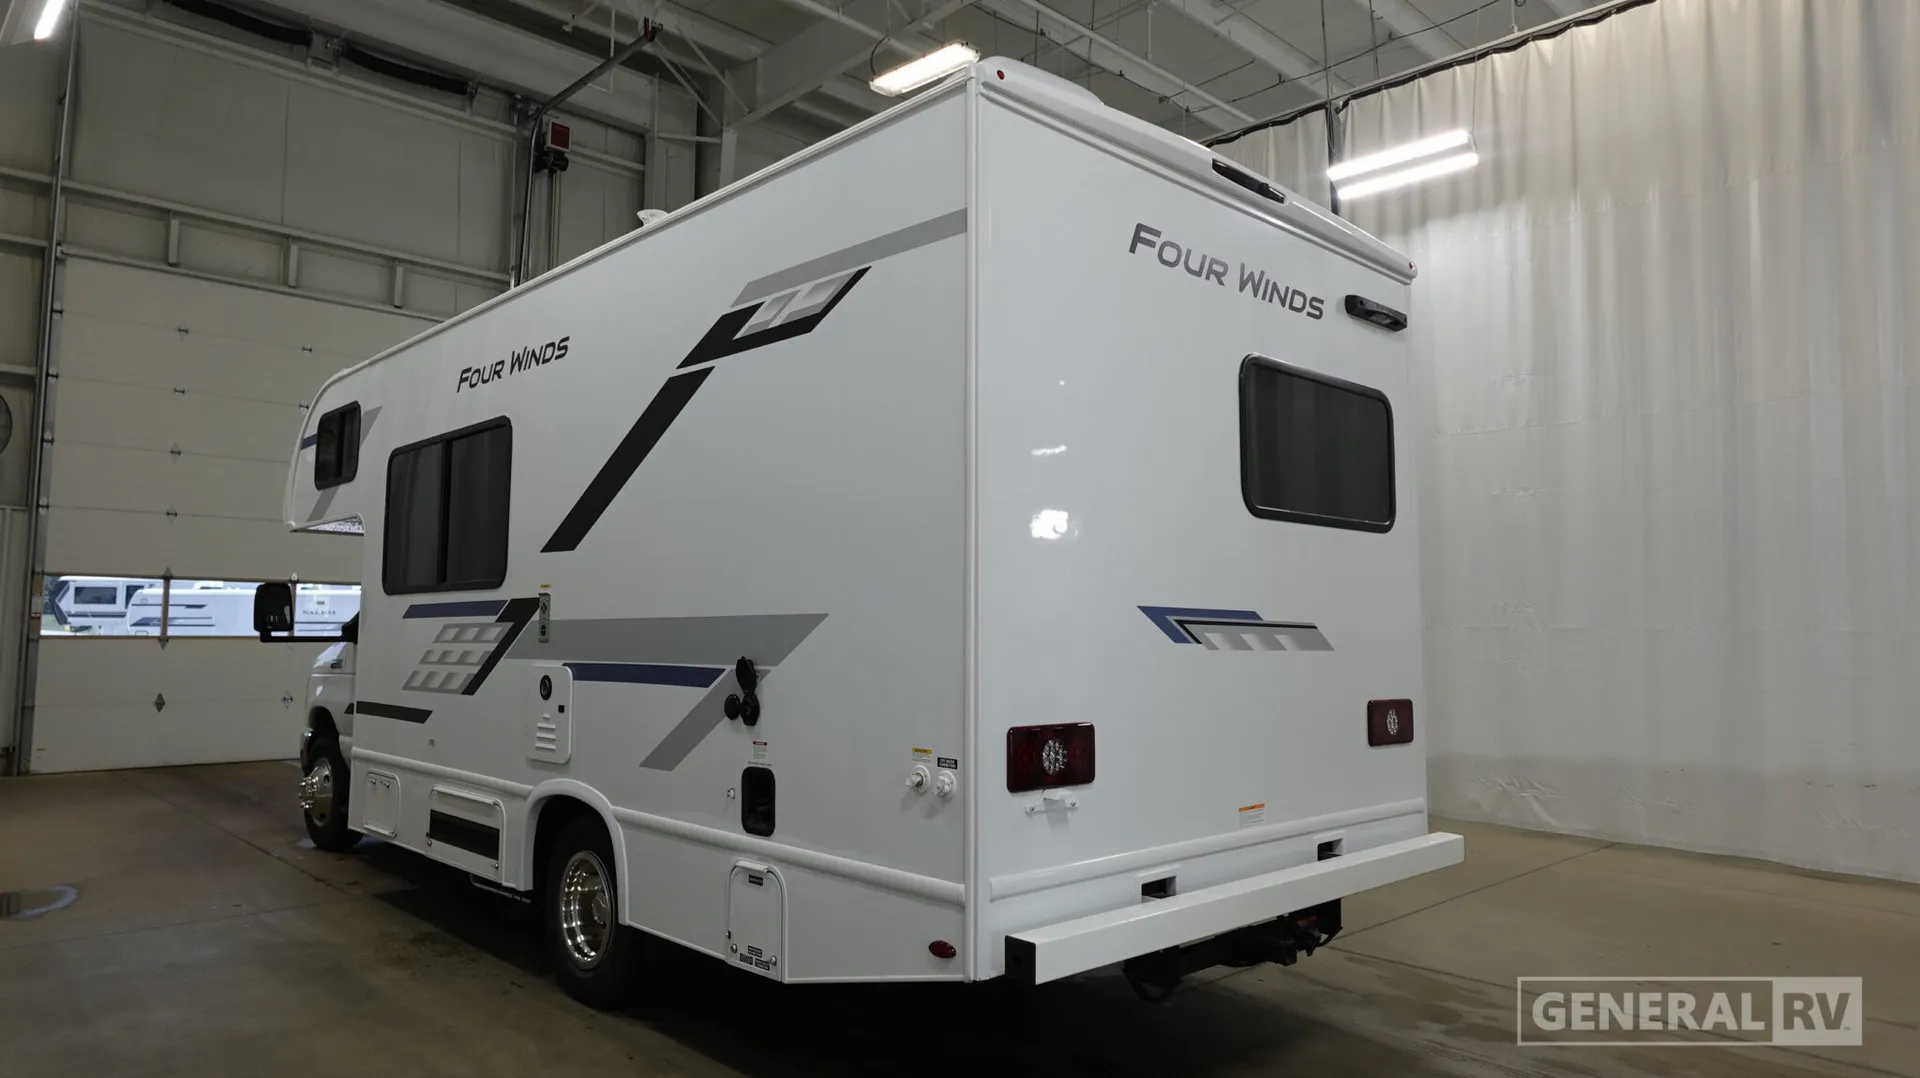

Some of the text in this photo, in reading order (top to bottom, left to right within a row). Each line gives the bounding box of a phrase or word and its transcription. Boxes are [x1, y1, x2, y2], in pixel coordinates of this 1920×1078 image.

[1128, 222, 1325, 320] FOUR WINDS
[456, 336, 570, 393] FOUR WINDS
